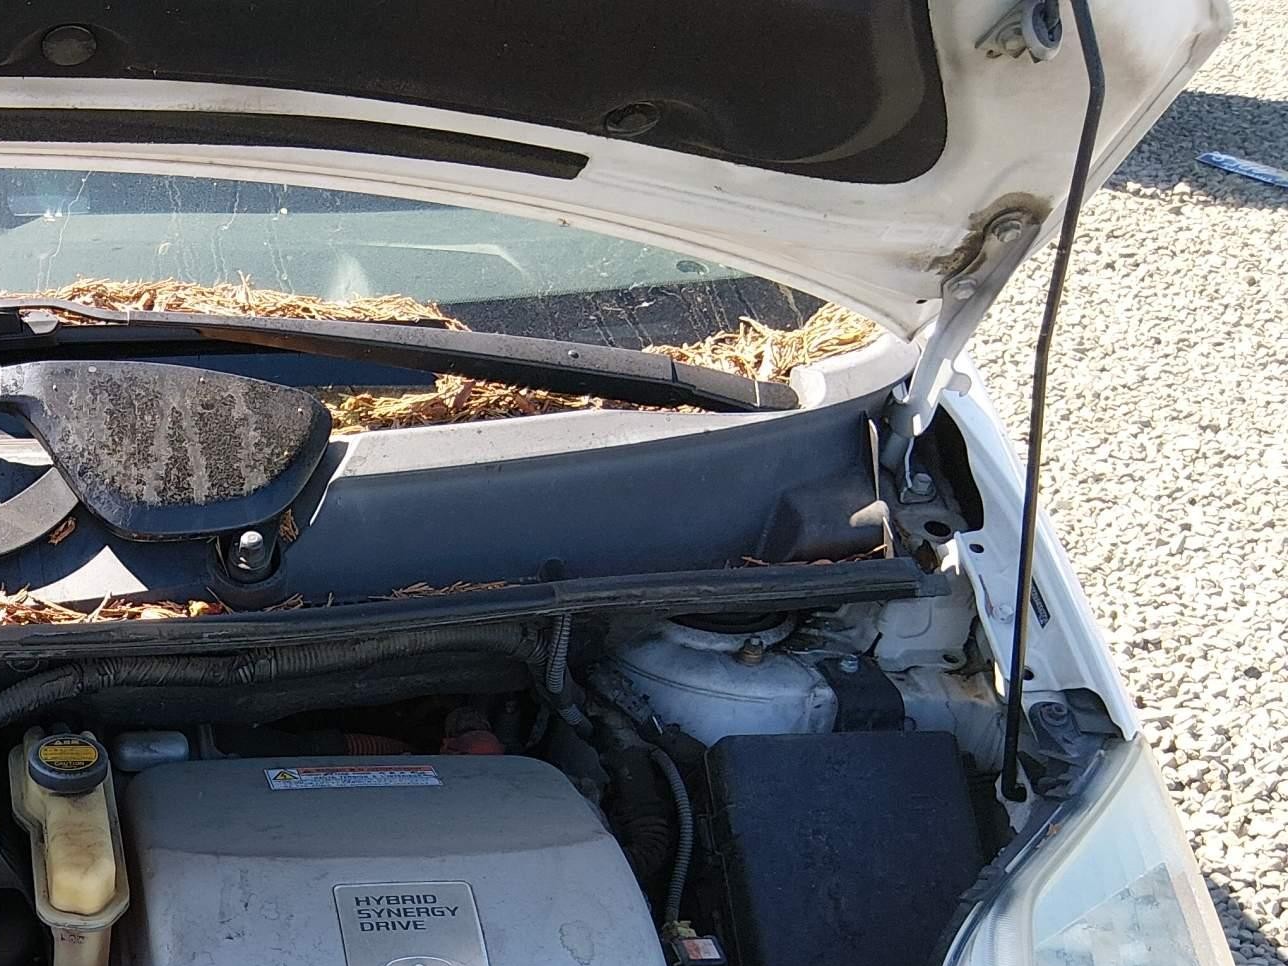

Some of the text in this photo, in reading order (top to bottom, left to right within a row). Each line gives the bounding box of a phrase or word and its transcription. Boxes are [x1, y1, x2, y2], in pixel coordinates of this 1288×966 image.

[355, 894, 437, 906] HYBRID
[357, 906, 459, 919] SYNERGY
[359, 920, 427, 932] DRIVE
